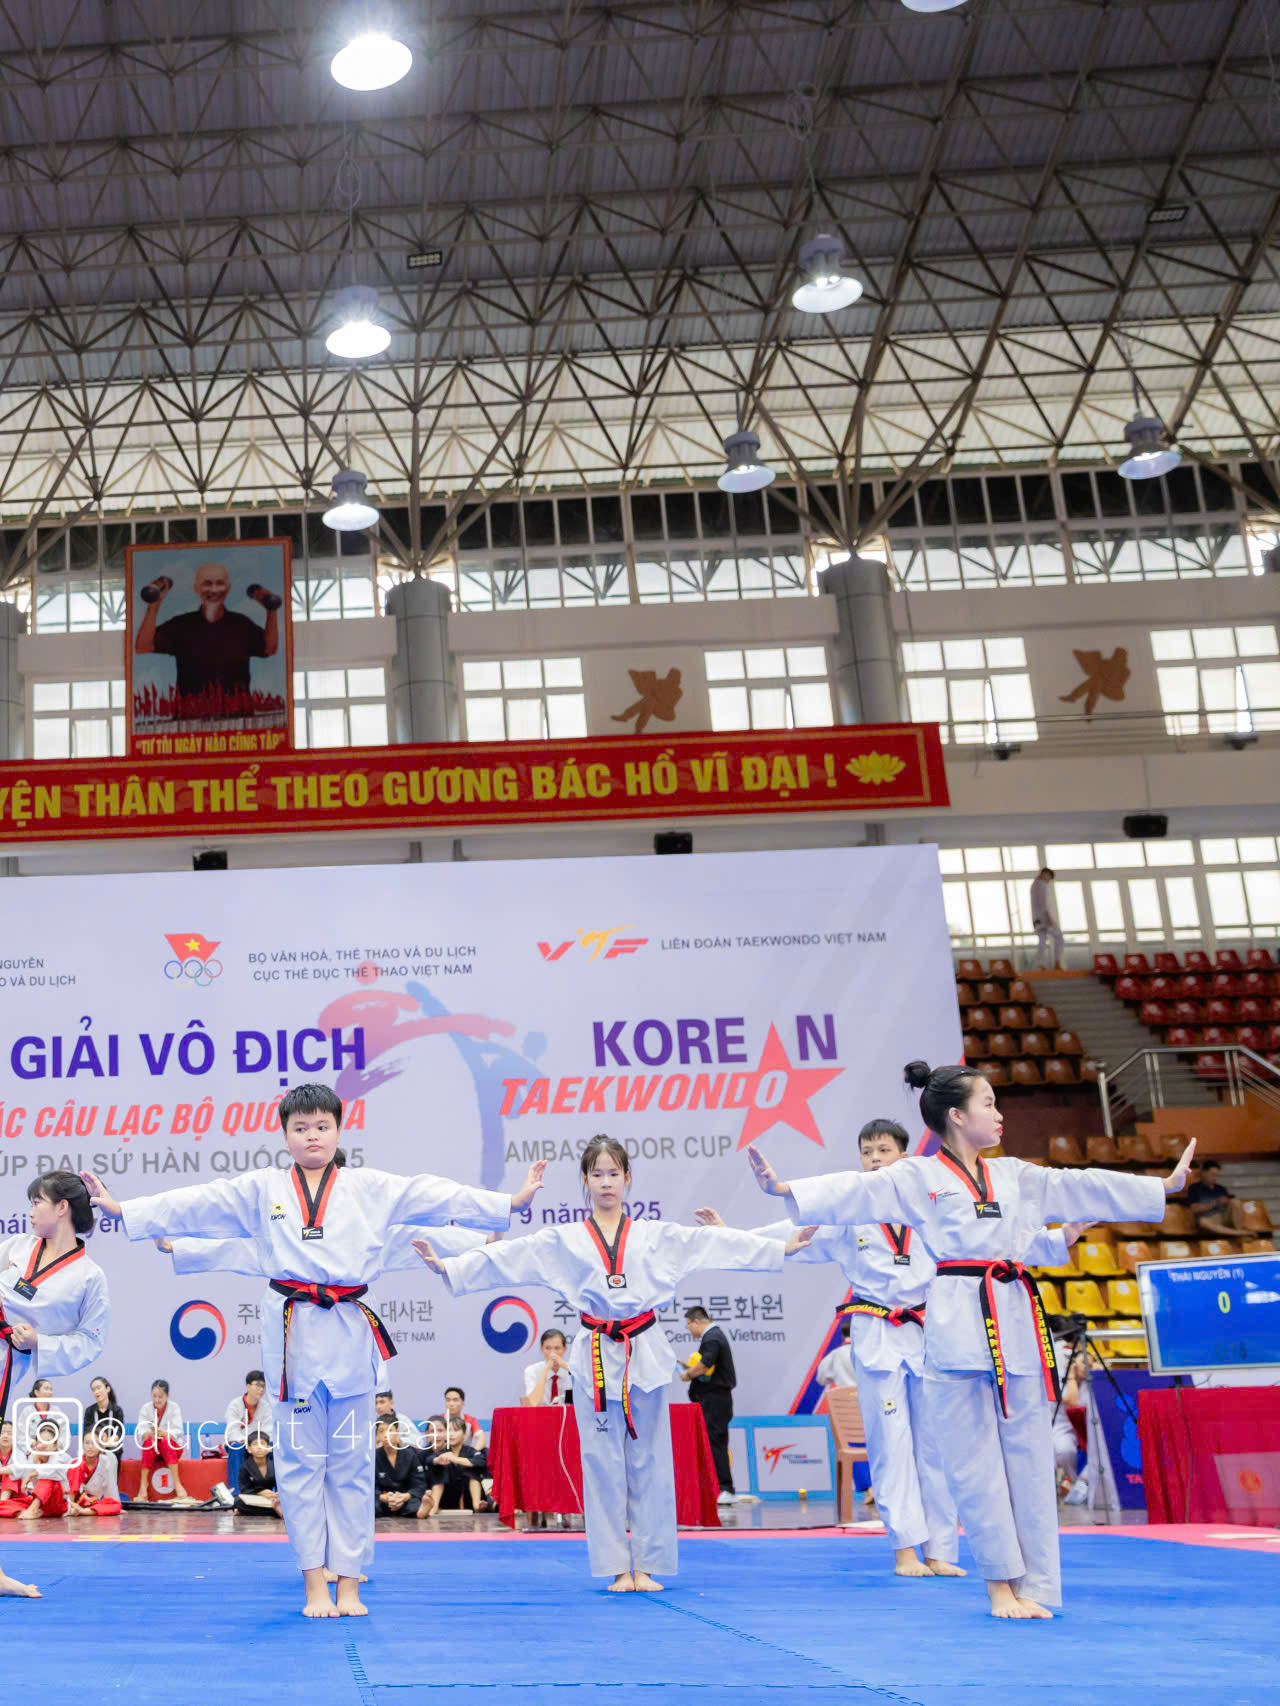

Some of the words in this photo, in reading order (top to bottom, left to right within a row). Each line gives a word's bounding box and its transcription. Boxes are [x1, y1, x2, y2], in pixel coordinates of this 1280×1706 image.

[73, 775, 175, 818] THÂN
[188, 764, 260, 814] THỂ
[271, 772, 369, 810] THEO
[383, 766, 519, 805] GƯƠNG
[532, 757, 611, 800] BÁC
[626, 748, 678, 797] HỒ
[691, 751, 730, 794] VĨ
[741, 754, 810, 798] ĐẠI
[661, 937, 690, 951] LIÊN
[694, 935, 732, 949] ĐOÀN
[735, 933, 821, 947] TAEKWONDO
[824, 931, 853, 946] VIỆT
[857, 931, 887, 943] NAM
[248, 950, 267, 965] BỘ
[365, 948, 401, 960] THAO
[404, 945, 422, 958] VÀ
[425, 947, 444, 957] DU
[447, 945, 477, 960] LỊCH
[10, 974, 26, 987] VÀ
[29, 976, 46, 986] DU
[49, 975, 76, 988] LỊCH
[253, 969, 280, 982] CỤC
[312, 967, 340, 981] DỤC
[373, 965, 408, 977] THAO
[412, 963, 440, 977] VIỆT
[444, 964, 473, 975] NAM
[10, 1016, 119, 1080] GIẢI
[139, 1020, 215, 1076] VÔ
[233, 1027, 366, 1086] ĐỊCH
[499, 1069, 789, 1117] TAEKWONDO
[33, 1097, 96, 1138] CÂU
[104, 1103, 166, 1142] LẠC
[171, 1097, 214, 1143] BỘ
[222, 1090, 282, 1136] QUỐ
[92, 1147, 133, 1175] SỨ
[143, 1146, 200, 1174] HÀN
[210, 1144, 292, 1173] QUỐC
[504, 1137, 677, 1163] AMBASDOR
[683, 1134, 733, 1159] CUP
[520, 1204, 532, 1224] 9
[542, 1203, 594, 1223] năm
[1218, 1291, 1231, 1314] 0
[411, 1332, 436, 1342] NAM
[729, 1327, 786, 1342] Vietnam
